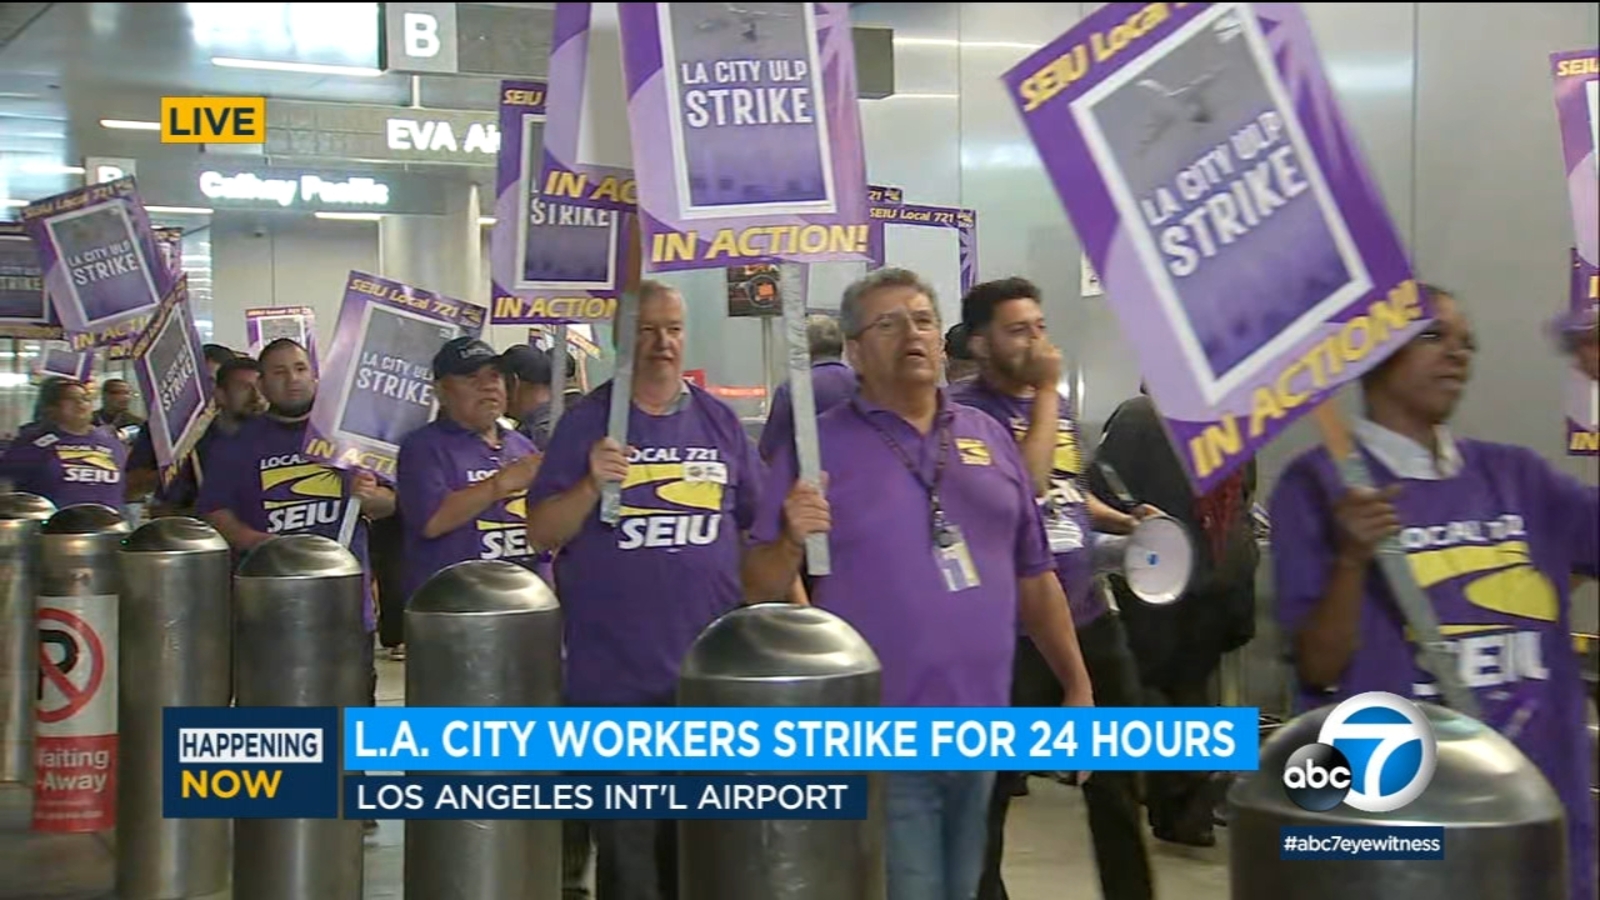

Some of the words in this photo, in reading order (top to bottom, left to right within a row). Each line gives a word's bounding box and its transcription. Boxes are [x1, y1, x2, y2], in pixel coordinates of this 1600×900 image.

[402, 12, 441, 58] B
[681, 62, 708, 84] LA
[714, 60, 761, 83] CITY
[769, 59, 808, 82] ULP
[1020, 43, 1089, 112] SEIU
[502, 89, 544, 106] SEIU
[684, 87, 813, 128] STRIKE
[386, 117, 458, 152] EVA
[543, 170, 588, 198] IN
[1139, 187, 1184, 226] LA
[1175, 143, 1235, 200] CITY
[1228, 110, 1282, 160] ULP
[530, 198, 611, 227] STRIKE
[869, 207, 898, 219] SEIU
[900, 208, 931, 221] Local
[933, 212, 955, 223] 721
[1159, 144, 1311, 278] STRIKE
[651, 230, 698, 263] IN
[704, 223, 870, 260] ACTION!
[73, 252, 140, 287] STRIKE
[349, 278, 388, 298] SEIU
[389, 289, 430, 312] Local
[431, 300, 461, 318] 721
[494, 297, 524, 319] IN
[73, 331, 96, 350] IN
[362, 351, 378, 367] LA
[381, 355, 411, 374] CITY
[1188, 412, 1244, 479] IN
[1249, 279, 1424, 438] ACTION!
[356, 367, 436, 406] STRIKE
[306, 437, 335, 459] IN
[684, 447, 719, 461] 721
[63, 467, 121, 484] SEIU
[266, 500, 342, 534] SEIU
[617, 514, 722, 550] SEIU
